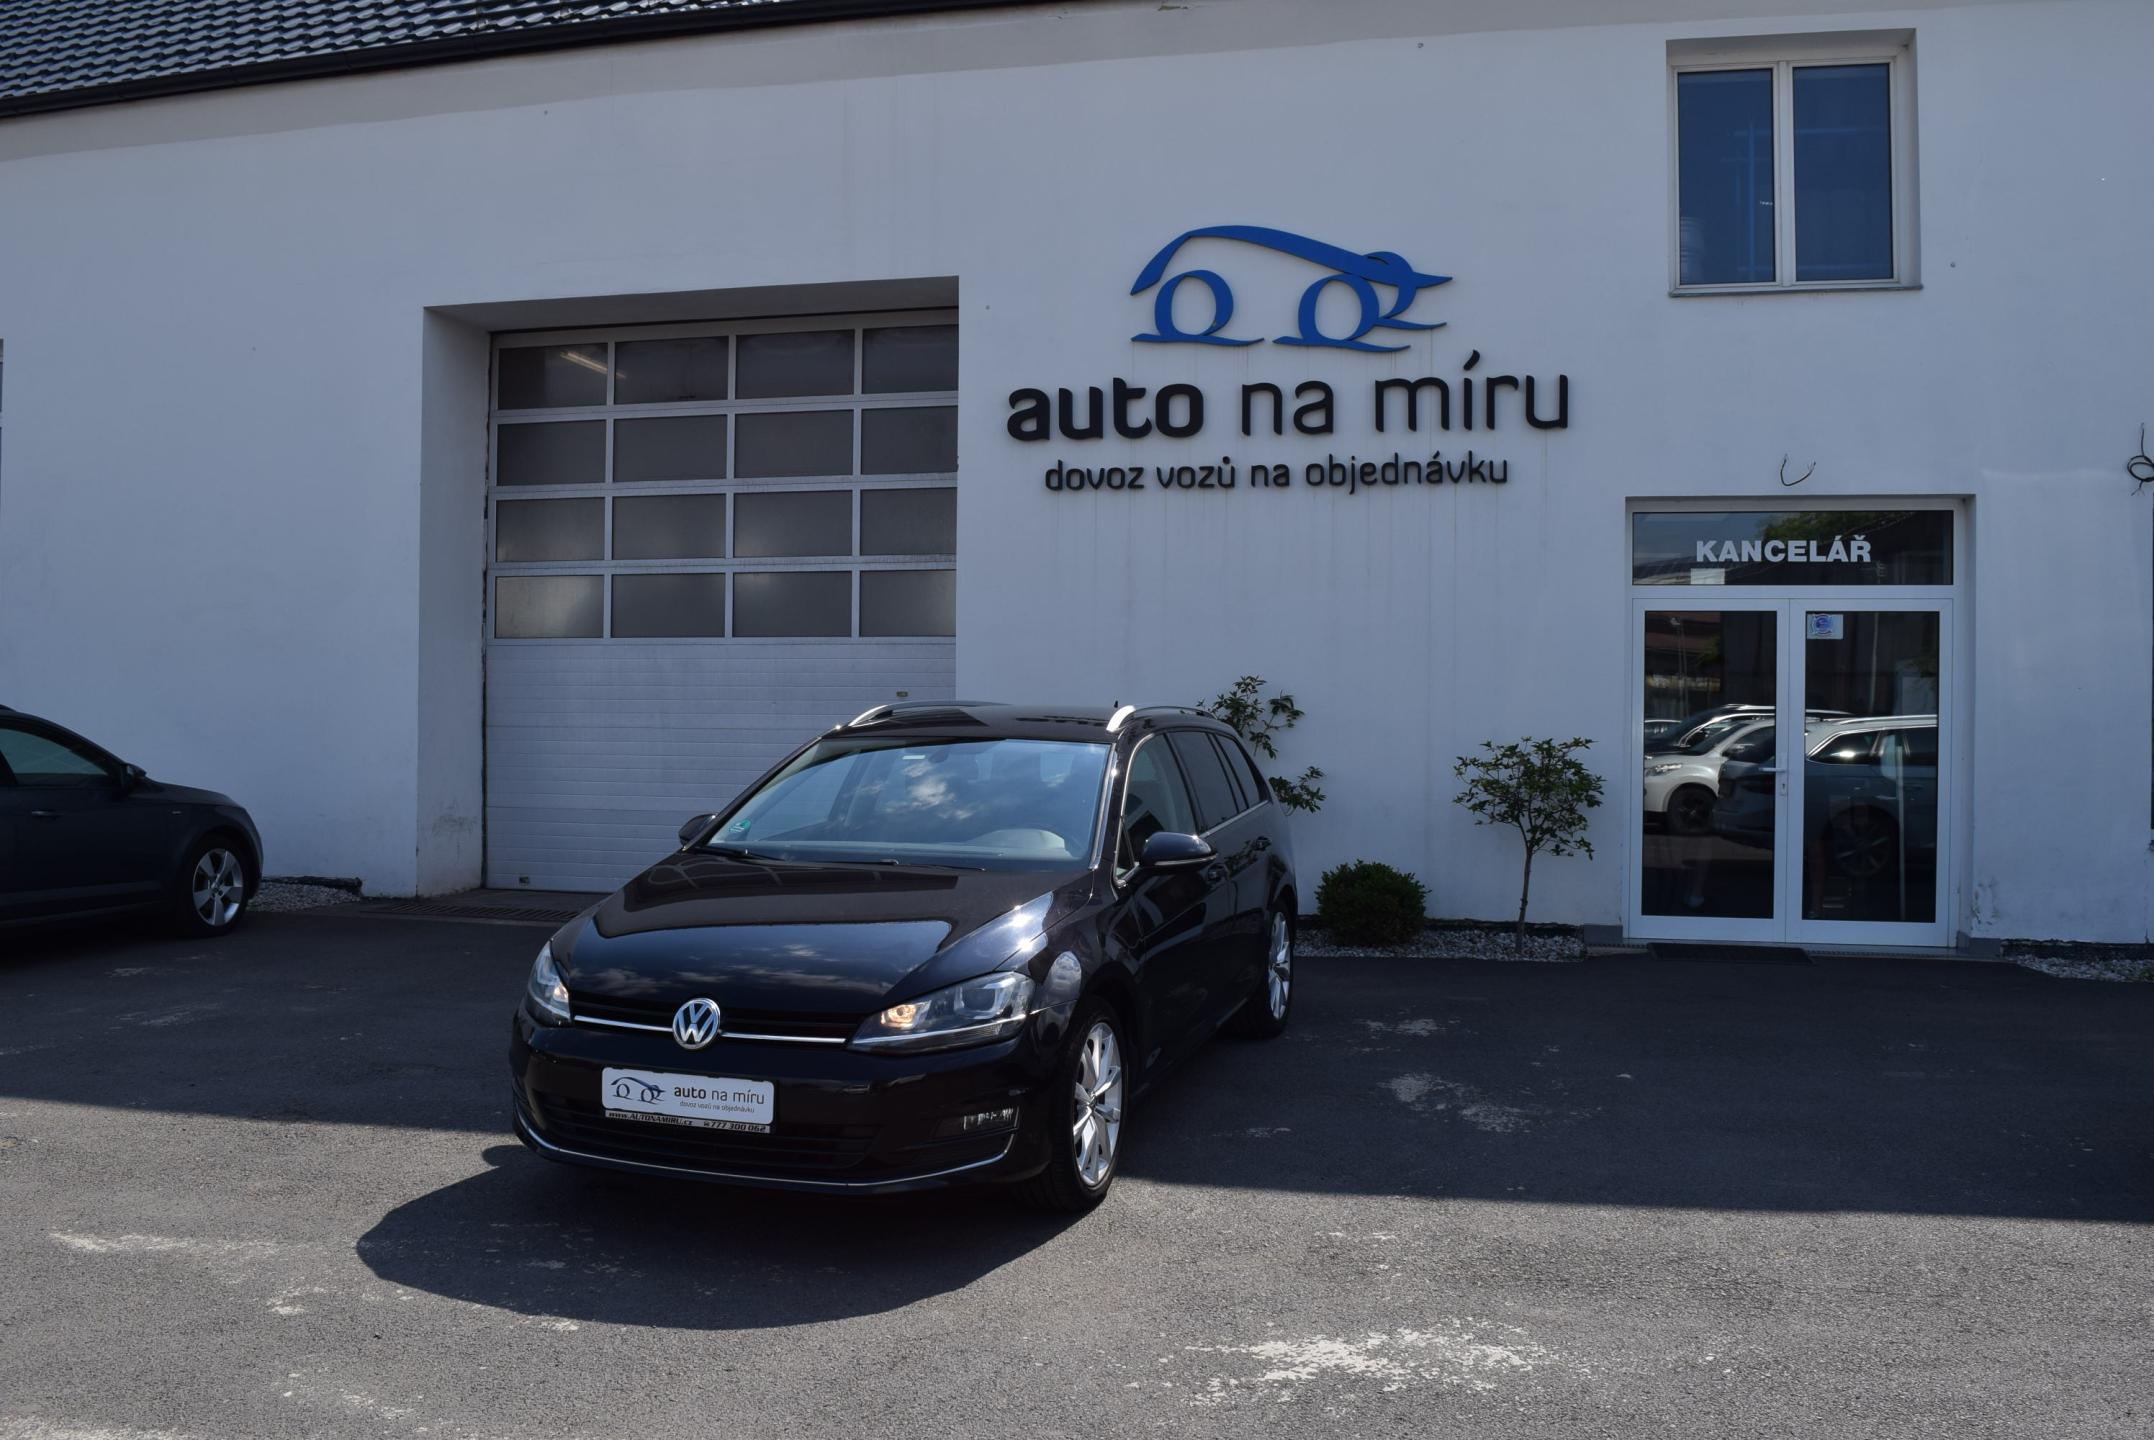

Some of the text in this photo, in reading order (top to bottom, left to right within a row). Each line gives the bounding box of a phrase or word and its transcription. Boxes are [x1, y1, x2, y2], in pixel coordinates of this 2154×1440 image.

[1006, 349, 1569, 441] auto na míru
[1045, 450, 1508, 494] dovoz vozů na objednávku
[1696, 535, 1872, 563] KANCELÁŘ
[674, 1086, 765, 1105] auto na míru
